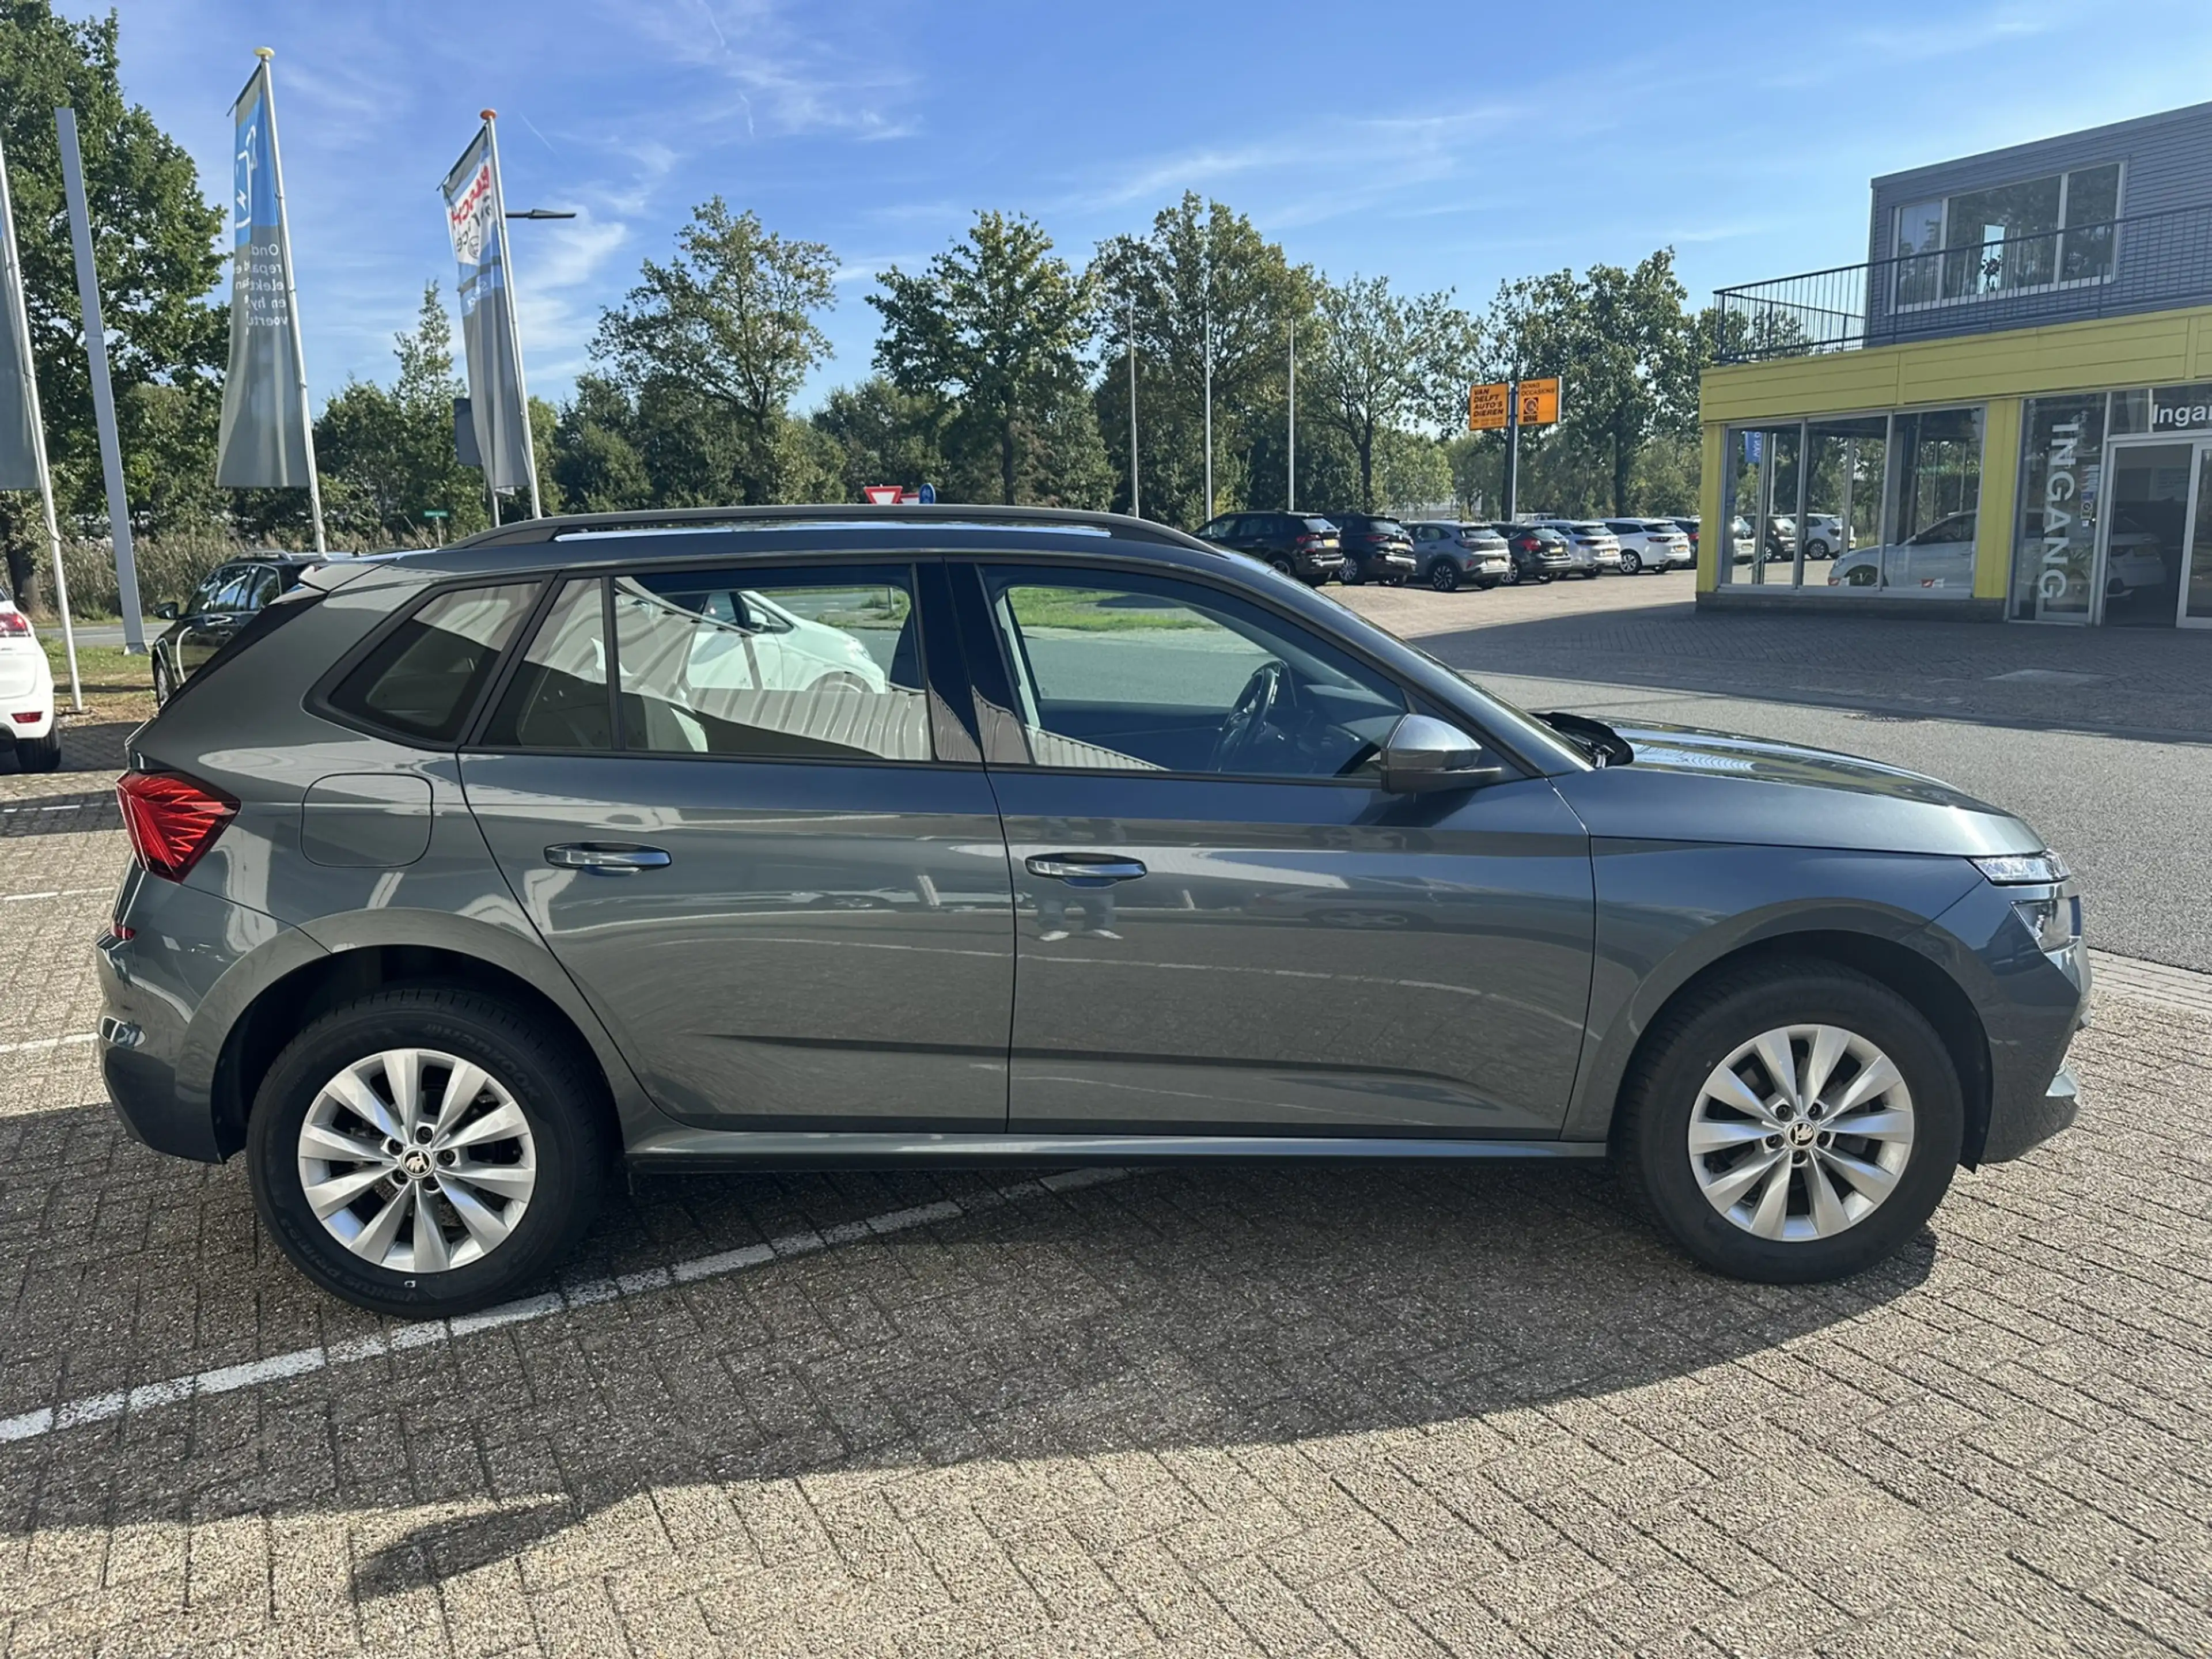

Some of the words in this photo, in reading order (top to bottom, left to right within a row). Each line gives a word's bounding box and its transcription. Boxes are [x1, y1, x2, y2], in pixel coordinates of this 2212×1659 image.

[1474, 394, 1500, 403] DELFT
[1473, 408, 1504, 417] DIEREN
[2039, 423, 2079, 599] INGANG
